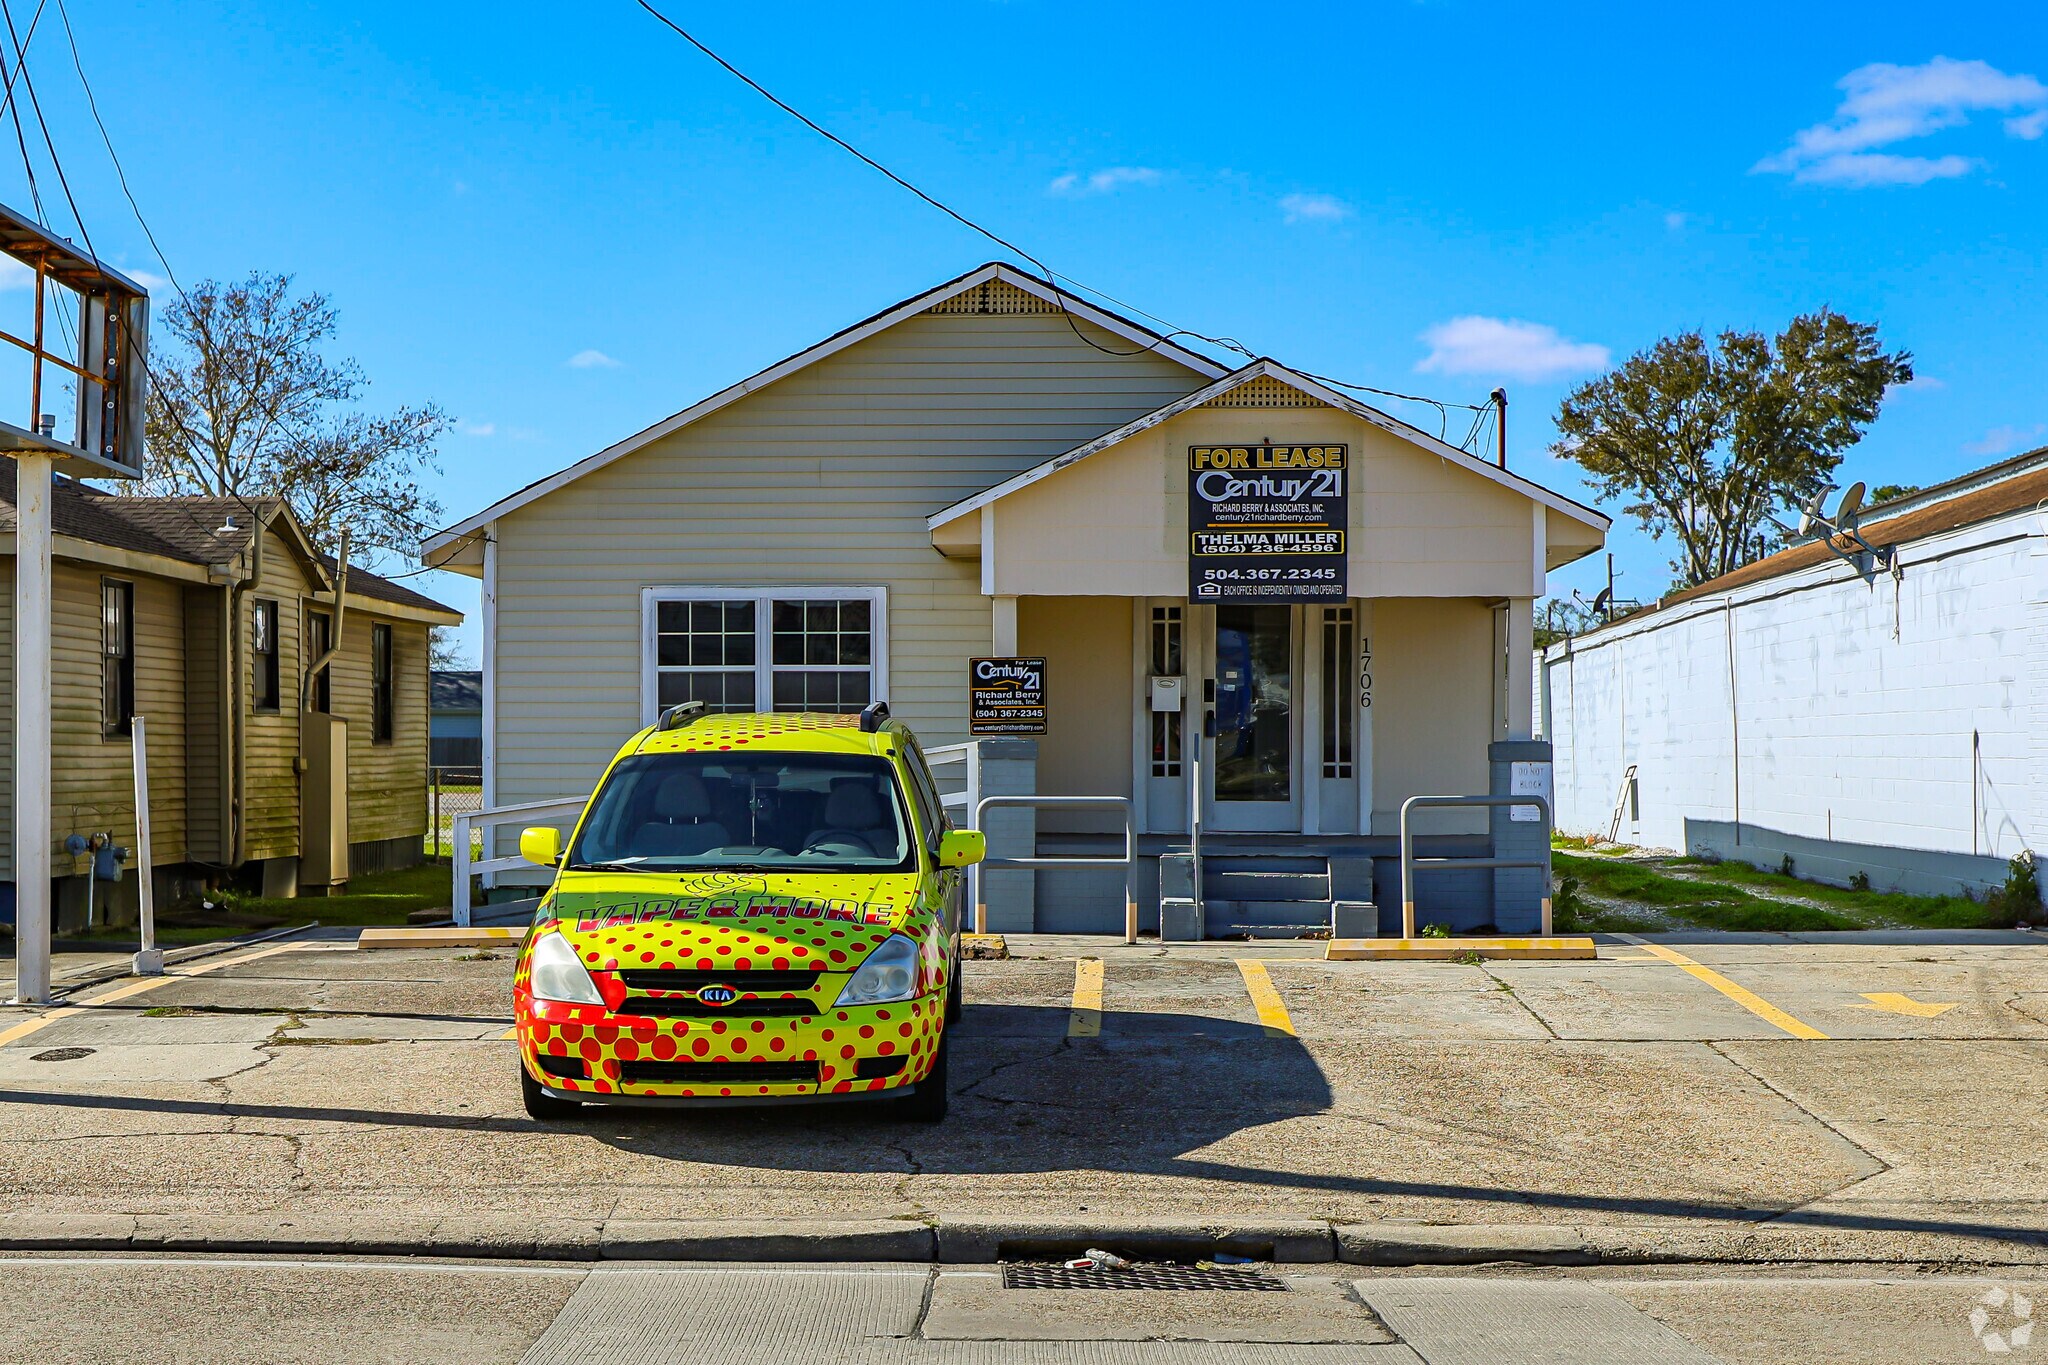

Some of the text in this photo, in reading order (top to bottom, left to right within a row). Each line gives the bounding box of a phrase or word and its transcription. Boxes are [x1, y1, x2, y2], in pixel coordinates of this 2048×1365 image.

[1195, 447, 1342, 469] FOR LEASE
[1212, 503, 1325, 514] RICHARD BERRY & ASSOCIATES, INC.
[1215, 513, 1322, 523] century21richardberry.com
[1198, 533, 1338, 545] THELMA MILLER
[1202, 544, 1335, 554] (504) 236-4596
[1204, 569, 1336, 580] 504.367.2345
[1223, 585, 1237, 596] EACH
[1237, 585, 1253, 595] OFFICE
[1310, 585, 1320, 595] AND
[1320, 584, 1343, 595] OPERATED
[976, 661, 1040, 689] Century 21
[1360, 637, 1372, 708] 1706
[975, 691, 1041, 700] Richard Berry
[975, 709, 1043, 718] (504) 367-2345
[703, 990, 732, 1001] KIA
